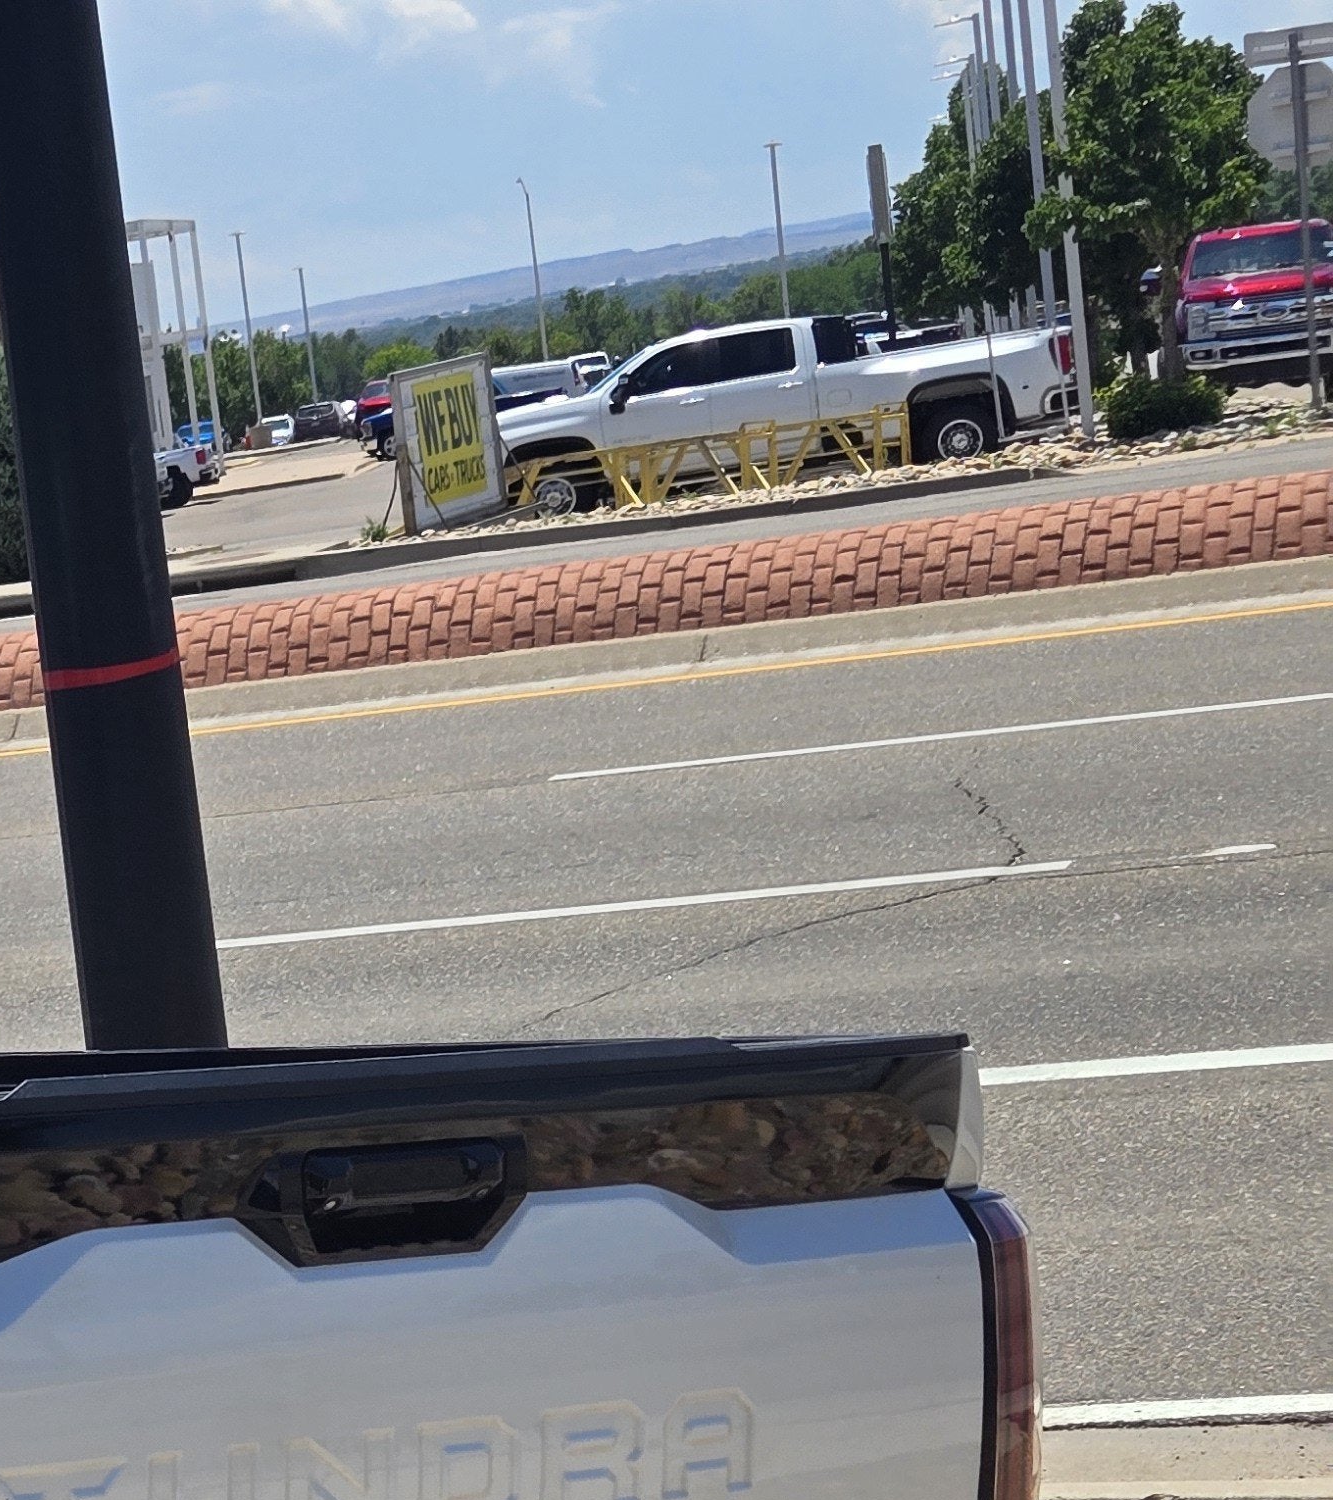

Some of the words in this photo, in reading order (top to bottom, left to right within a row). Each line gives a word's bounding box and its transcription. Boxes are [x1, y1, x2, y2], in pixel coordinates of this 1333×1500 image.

[417, 389, 448, 456] WE
[444, 383, 480, 450] BUY
[427, 462, 451, 494] CARS
